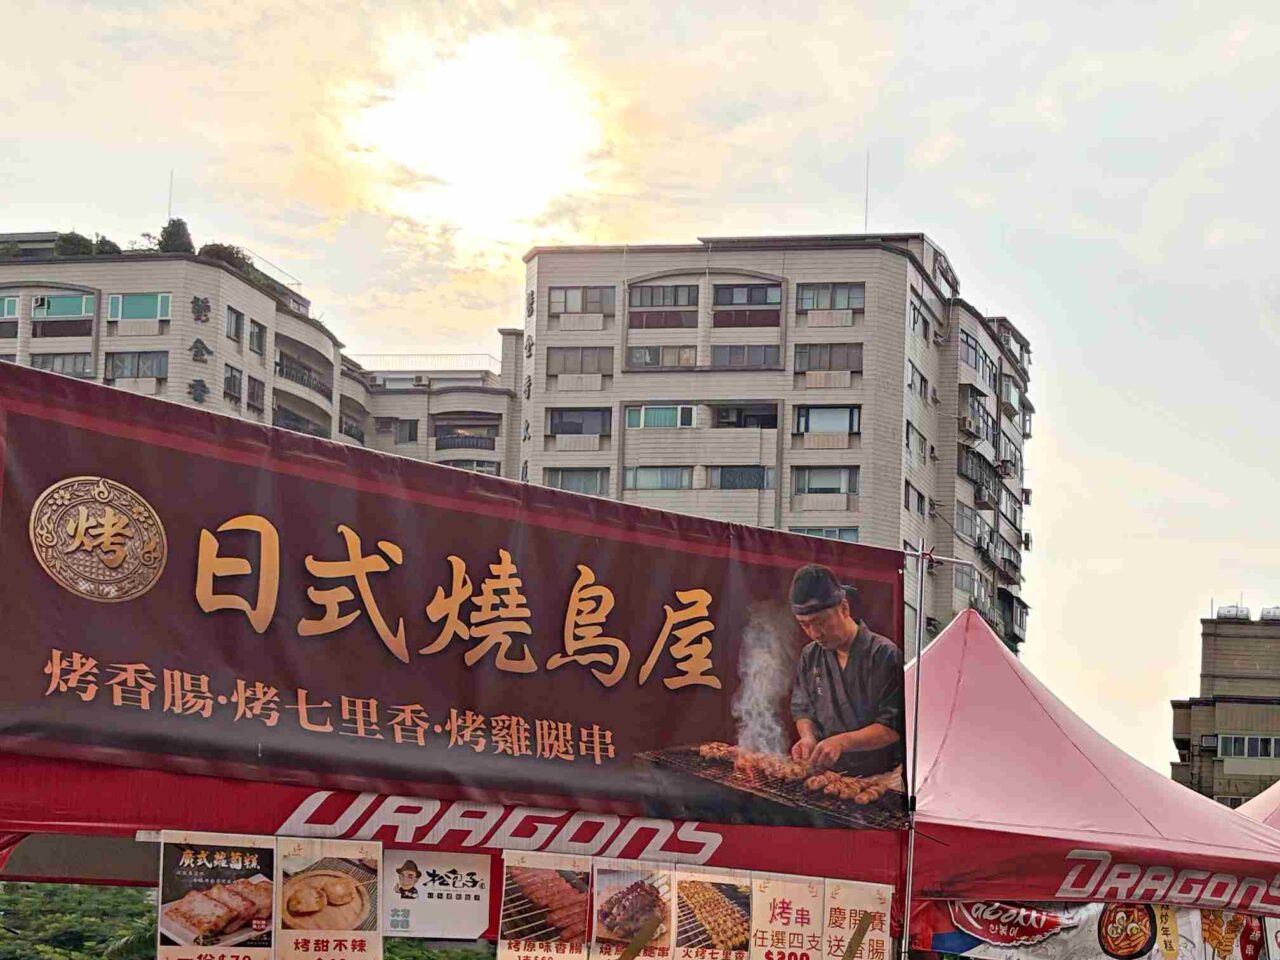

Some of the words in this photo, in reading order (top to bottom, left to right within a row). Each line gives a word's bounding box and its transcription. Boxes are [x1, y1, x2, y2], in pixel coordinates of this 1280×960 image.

[66, 509, 132, 569] 烤
[196, 514, 722, 692] 日式燒鳥屋
[45, 648, 617, 766] 烤香腸·烤七里香·烤雞腿串
[768, 897, 811, 928] 烤串
[293, 939, 367, 953] 烤甜不辣
[507, 940, 583, 955] 烤原味香腸
[599, 943, 671, 958] 燒鳥腿串
[752, 929, 823, 951] 任選四支
[681, 947, 746, 960] 火烤七里香
